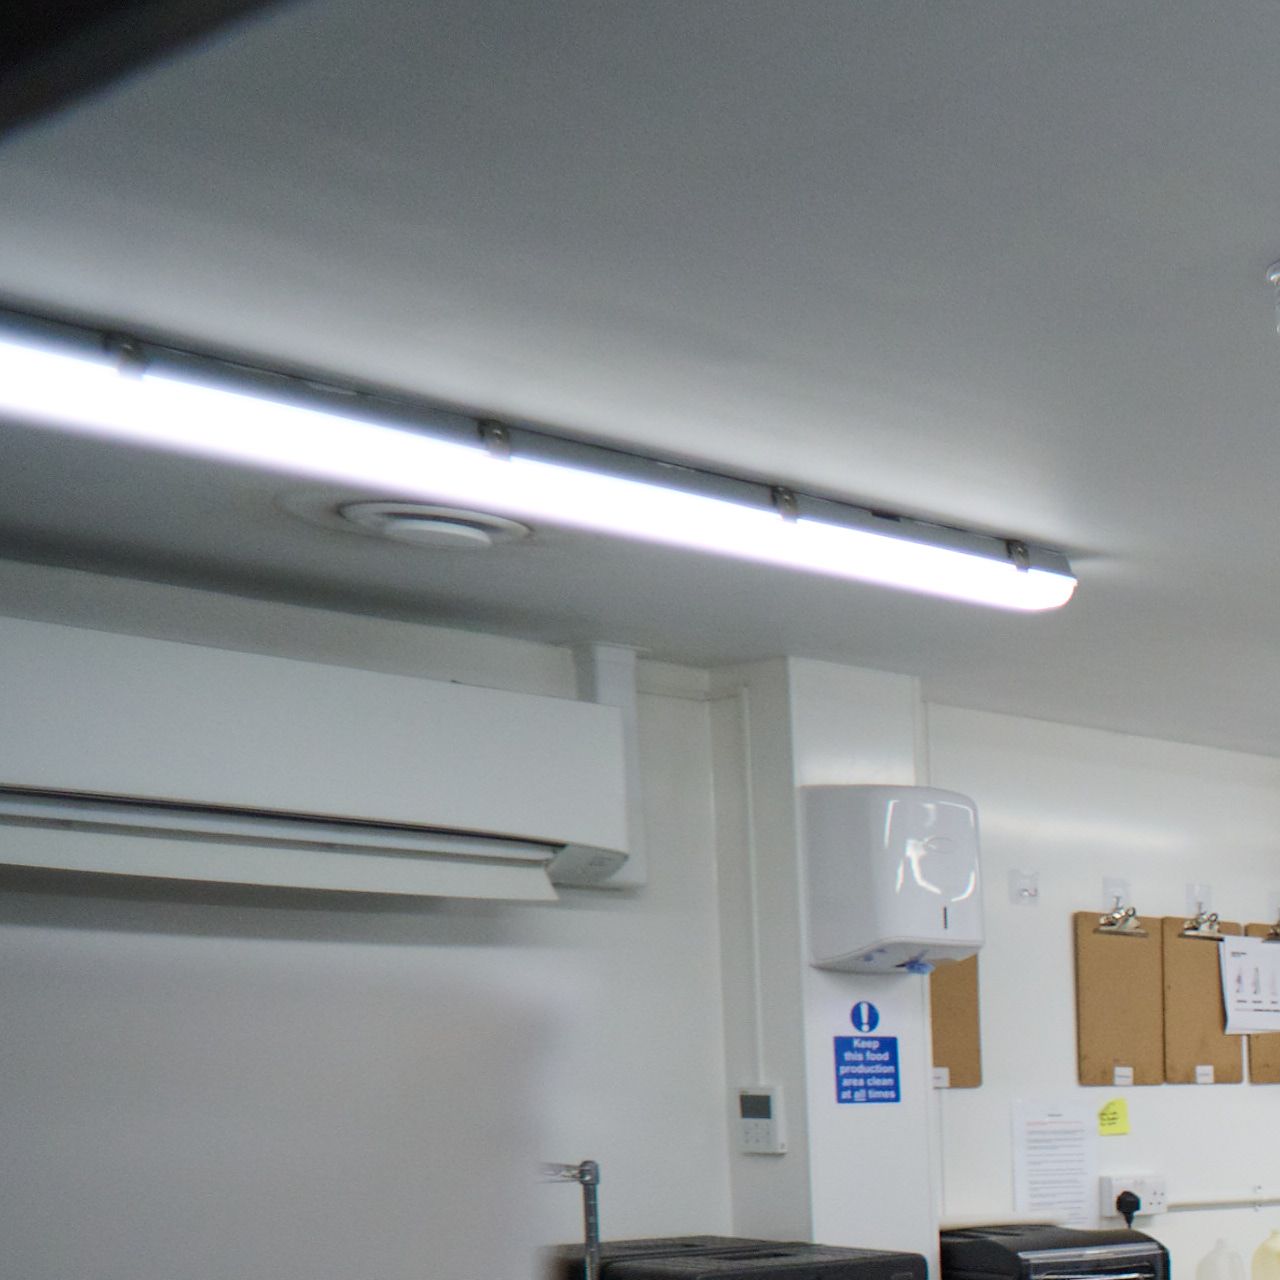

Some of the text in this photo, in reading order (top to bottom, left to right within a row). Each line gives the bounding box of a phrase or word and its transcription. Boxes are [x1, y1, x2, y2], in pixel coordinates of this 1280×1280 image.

[853, 1038, 880, 1050] Keep
[844, 1050, 889, 1061] this food
[839, 1064, 895, 1075] production
[842, 1076, 895, 1086] area clean
[841, 1089, 896, 1101] at all times
